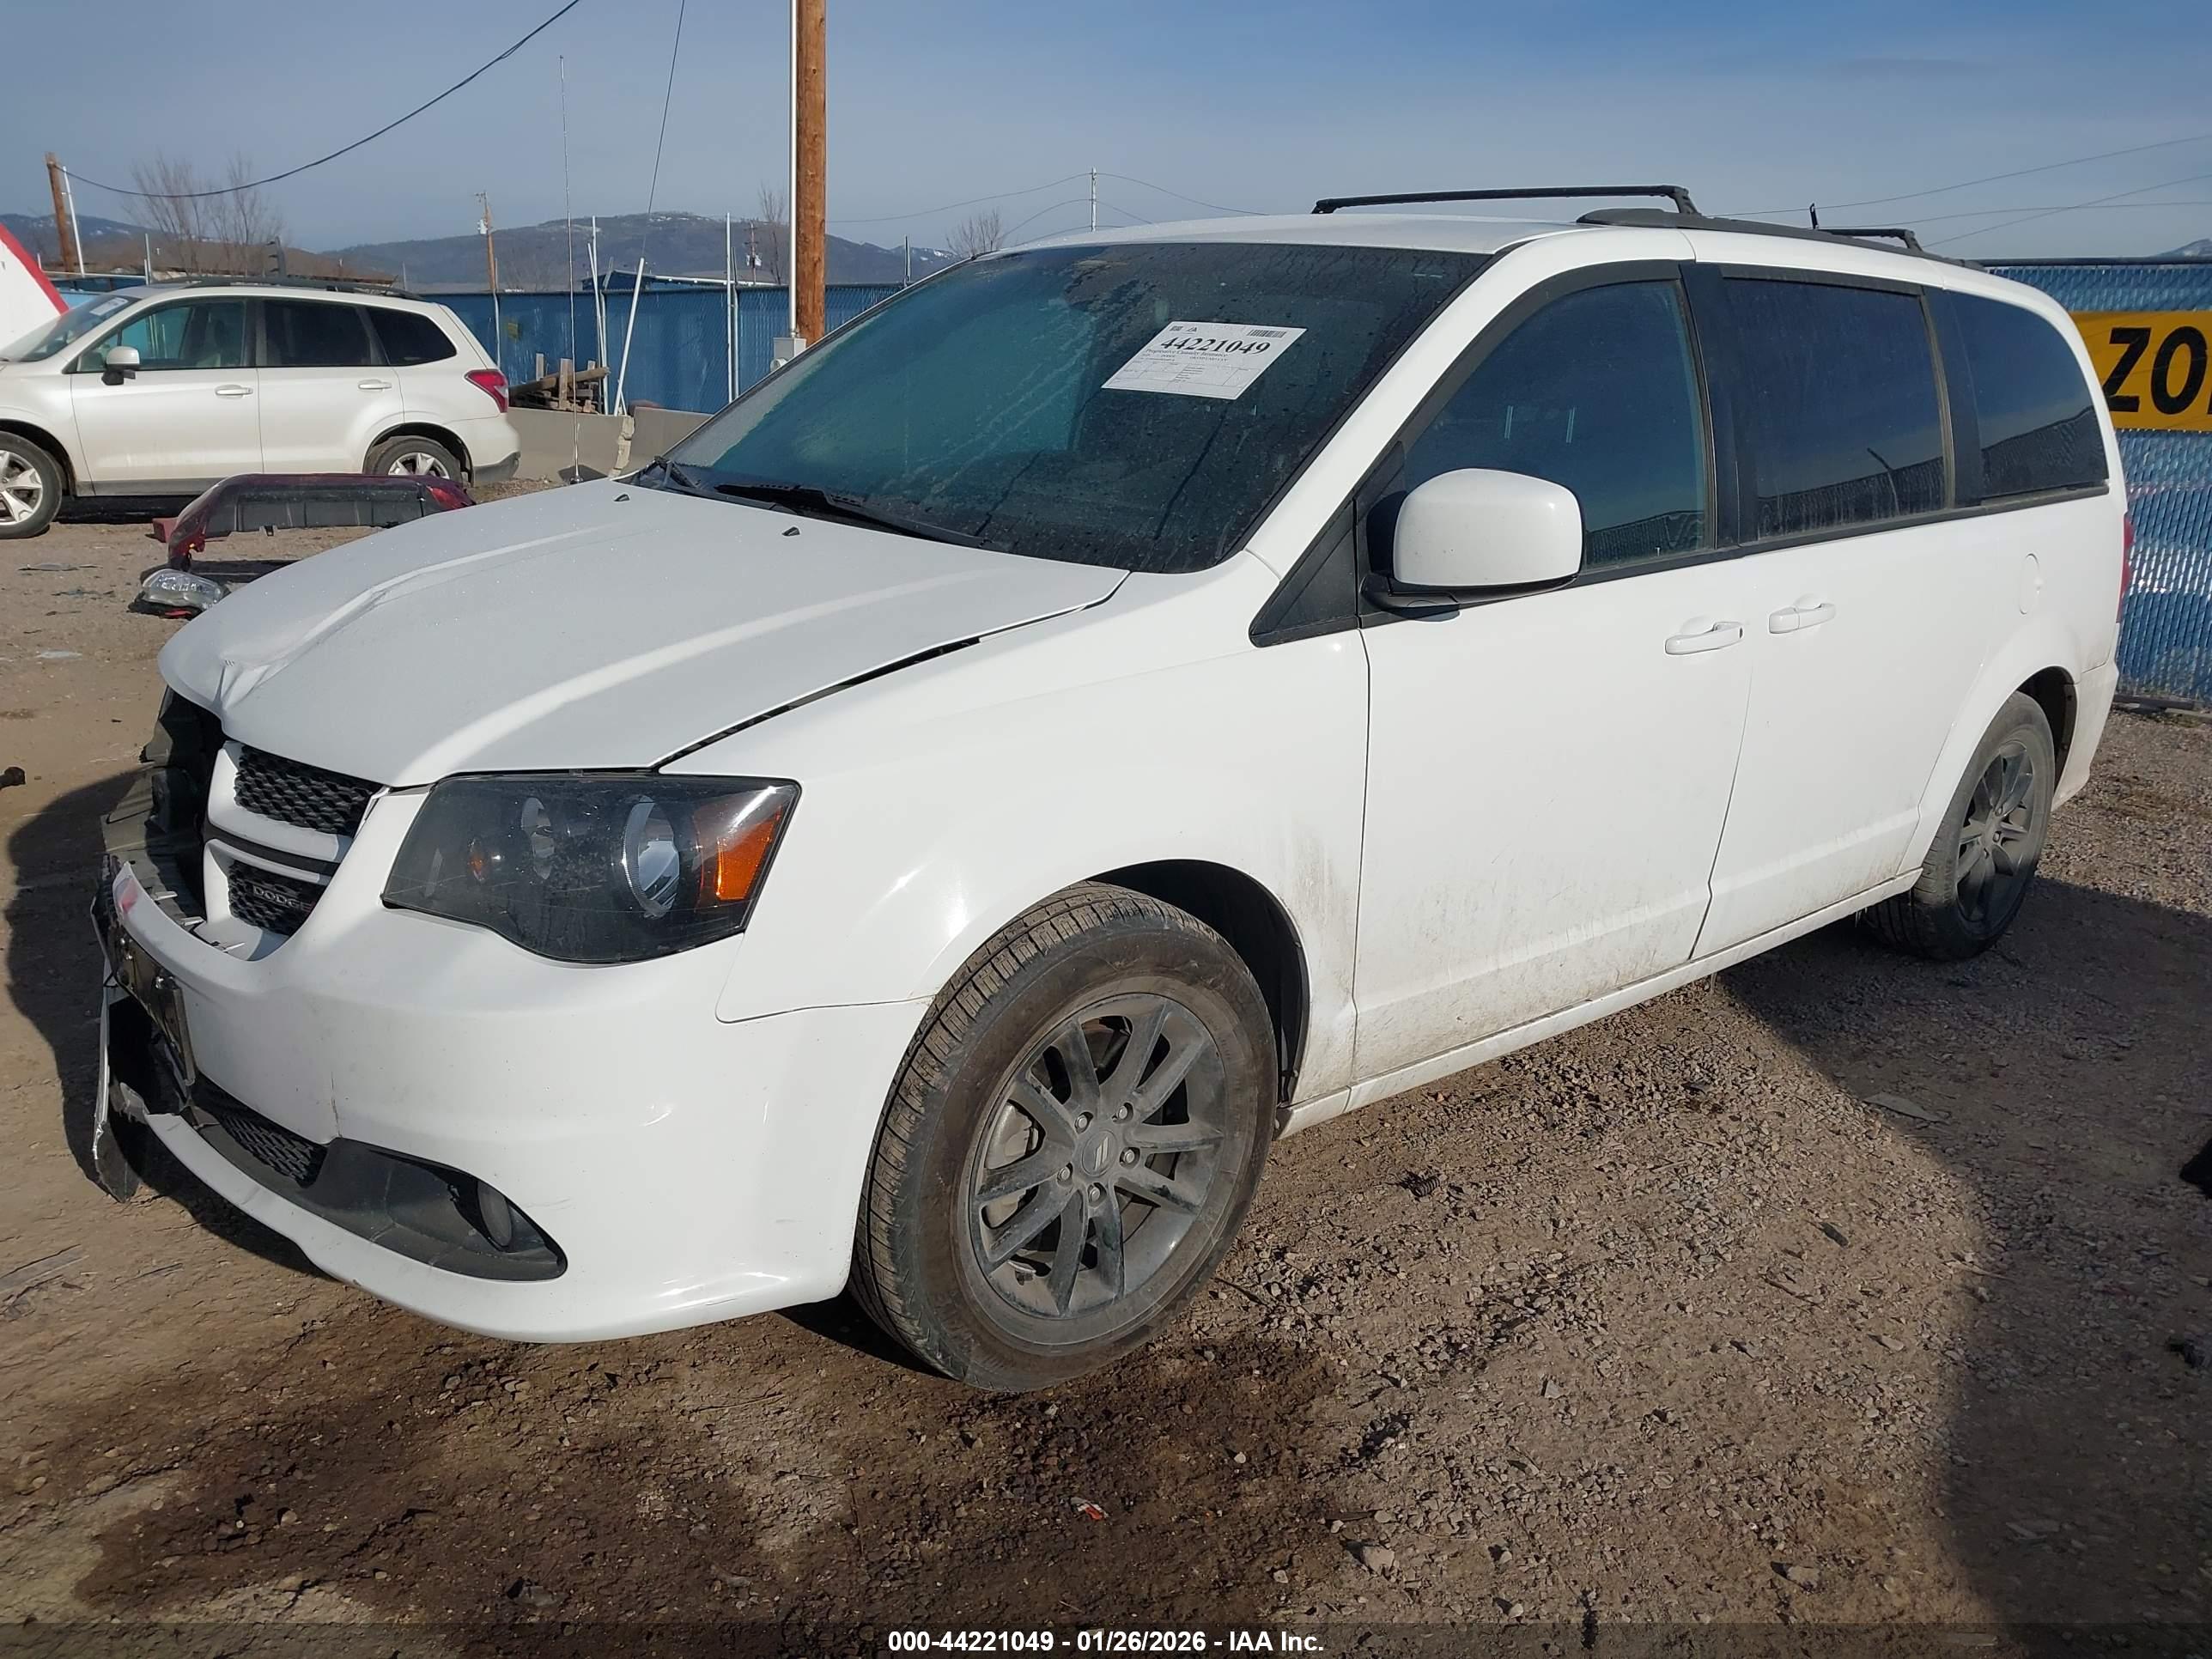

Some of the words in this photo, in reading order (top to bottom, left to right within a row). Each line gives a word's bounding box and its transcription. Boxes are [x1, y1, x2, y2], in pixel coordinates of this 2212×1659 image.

[1160, 337, 1271, 354] 44221049
[2101, 326, 2212, 415] ZO
[252, 884, 312, 911] DODGE
